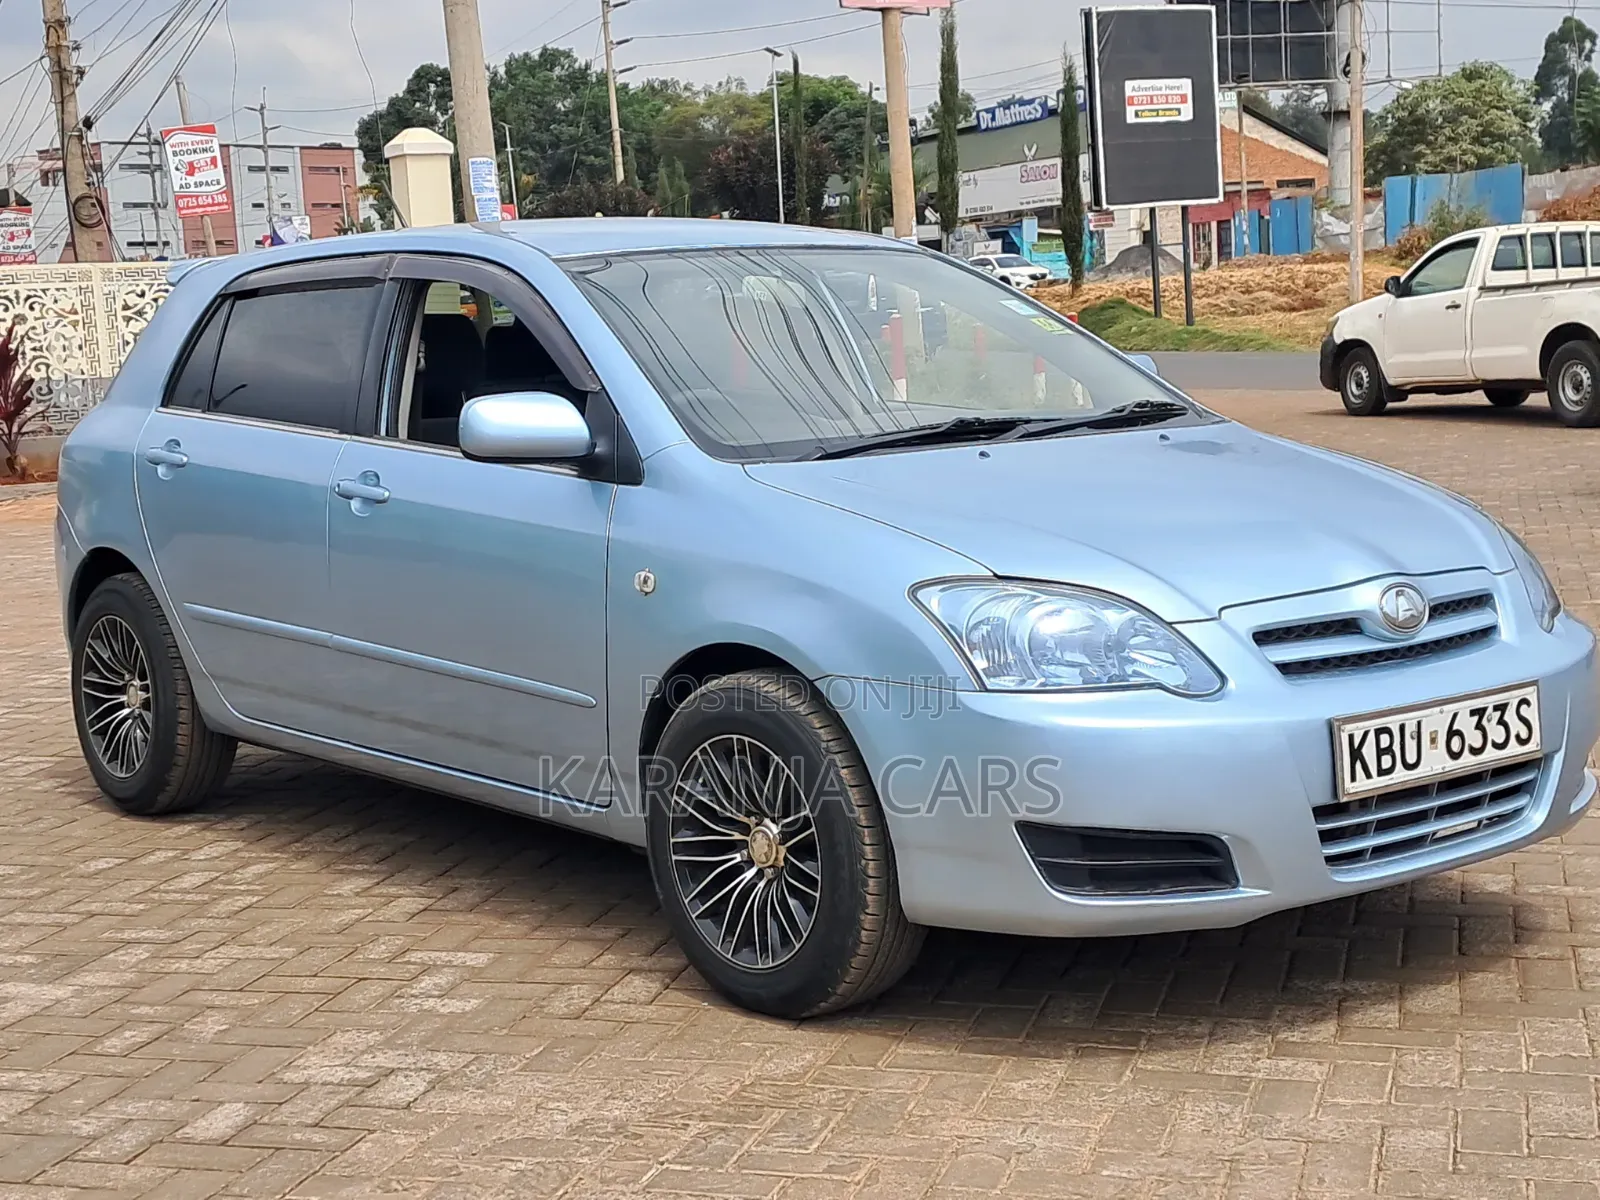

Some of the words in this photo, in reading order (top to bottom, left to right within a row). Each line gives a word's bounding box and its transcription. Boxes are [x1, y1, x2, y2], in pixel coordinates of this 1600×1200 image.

[1131, 84, 1163, 93] Advertise
[1165, 83, 1183, 91] Here!
[1133, 96, 1151, 105] 0721
[169, 141, 190, 149] WITH
[191, 139, 214, 147] EVERY
[172, 146, 215, 157] BOOKING
[179, 182, 191, 190] AD
[193, 179, 221, 188] SPACE
[178, 197, 197, 208] 0725
[1347, 719, 1424, 783] KBU
[1445, 697, 1534, 761] 633S
